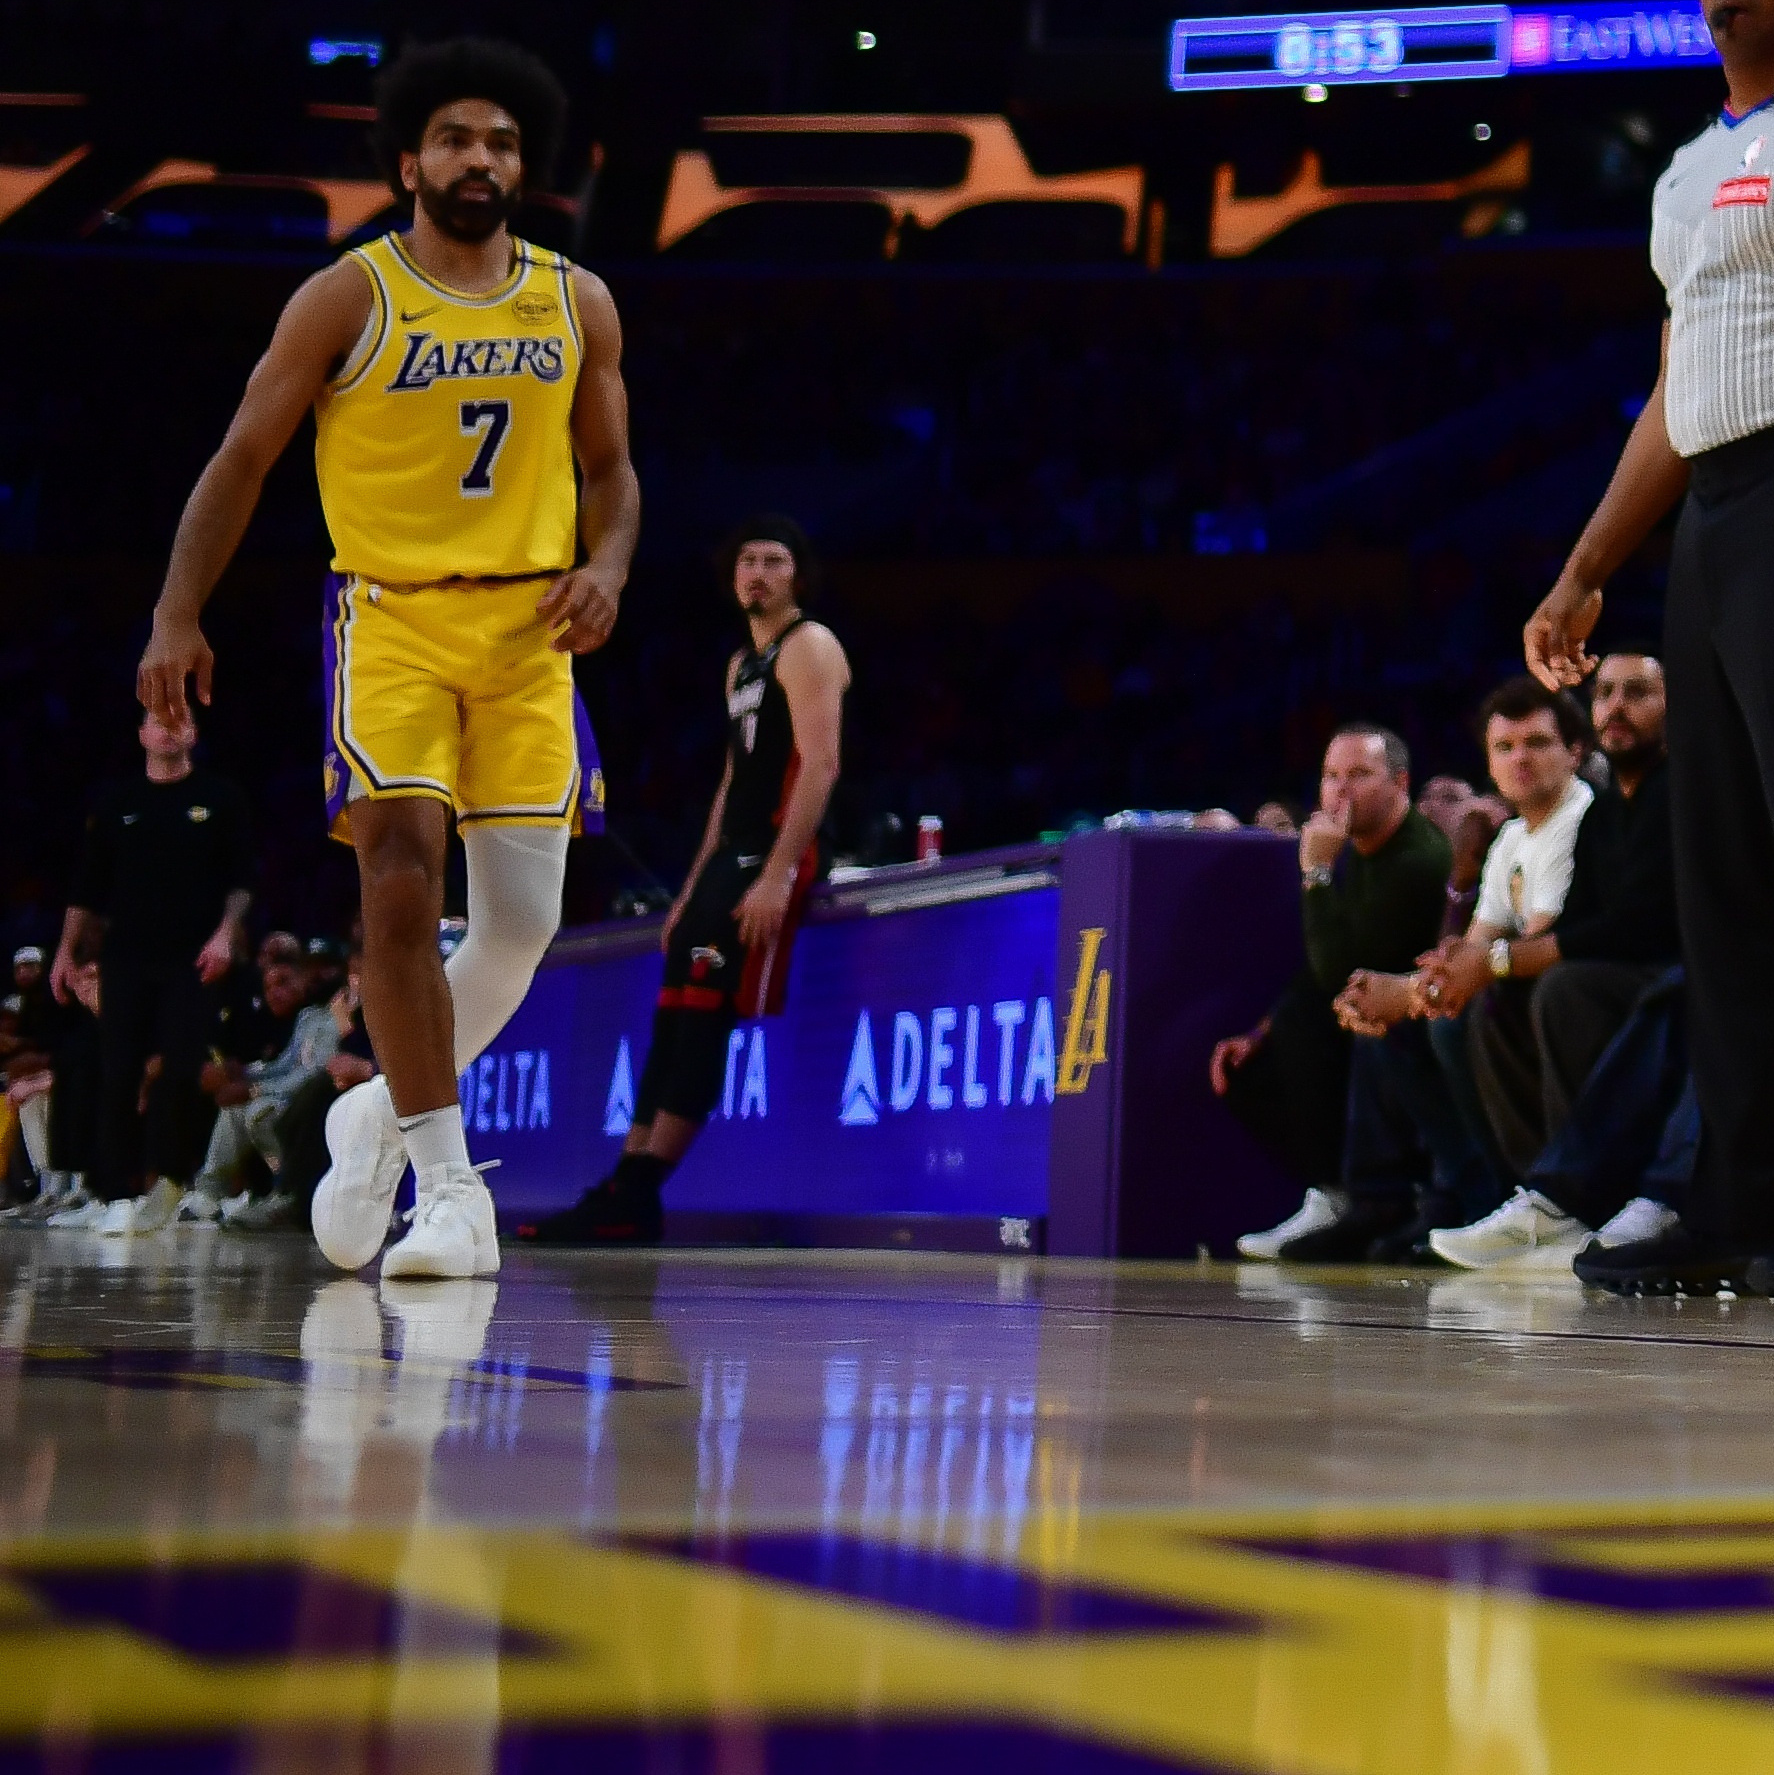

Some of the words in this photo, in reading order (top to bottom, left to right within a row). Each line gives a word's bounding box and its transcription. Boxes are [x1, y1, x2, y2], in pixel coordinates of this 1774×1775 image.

[387, 333, 564, 393] LAKERS
[458, 399, 513, 500] 7
[889, 996, 1056, 1113] DELTA
